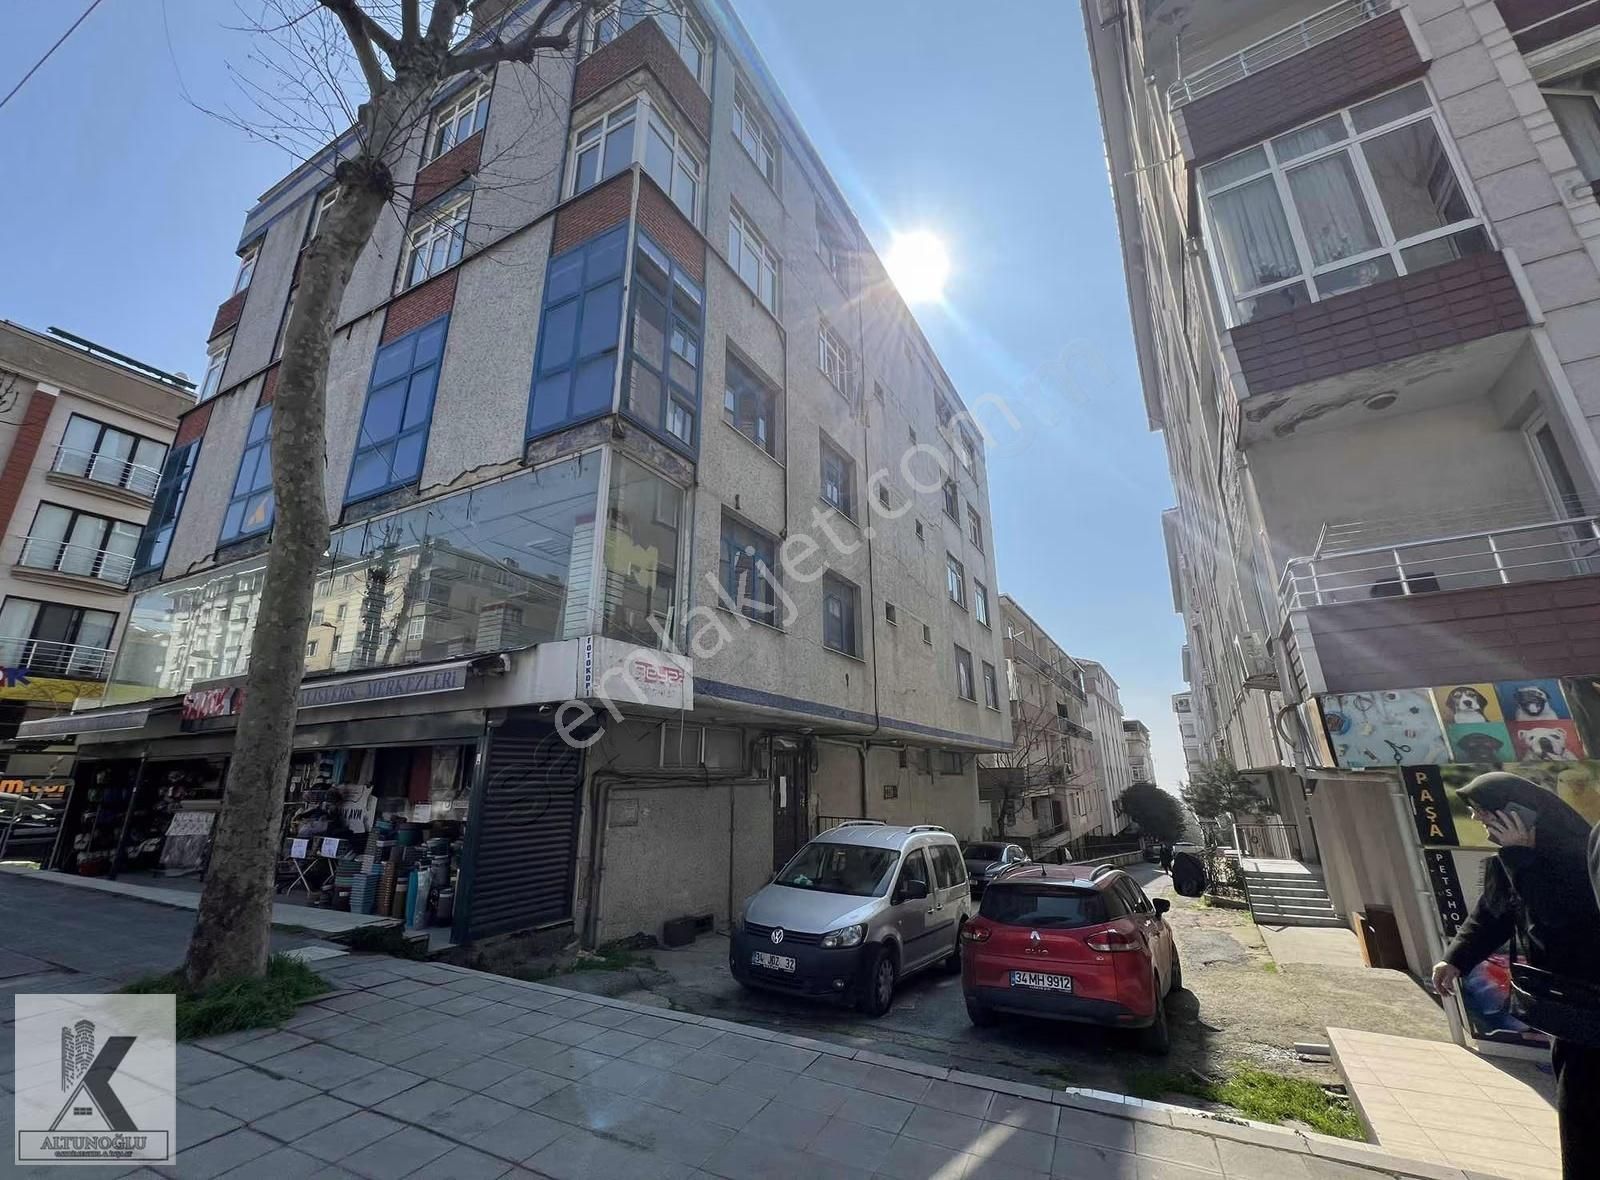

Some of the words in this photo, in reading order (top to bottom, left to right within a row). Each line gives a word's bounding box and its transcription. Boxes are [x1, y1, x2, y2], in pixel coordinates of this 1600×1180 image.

[1415, 772, 1444, 838] PAŞA
[1015, 972, 1028, 984] 34
[1029, 974, 1045, 986] MH
[1047, 976, 1071, 989] 9912
